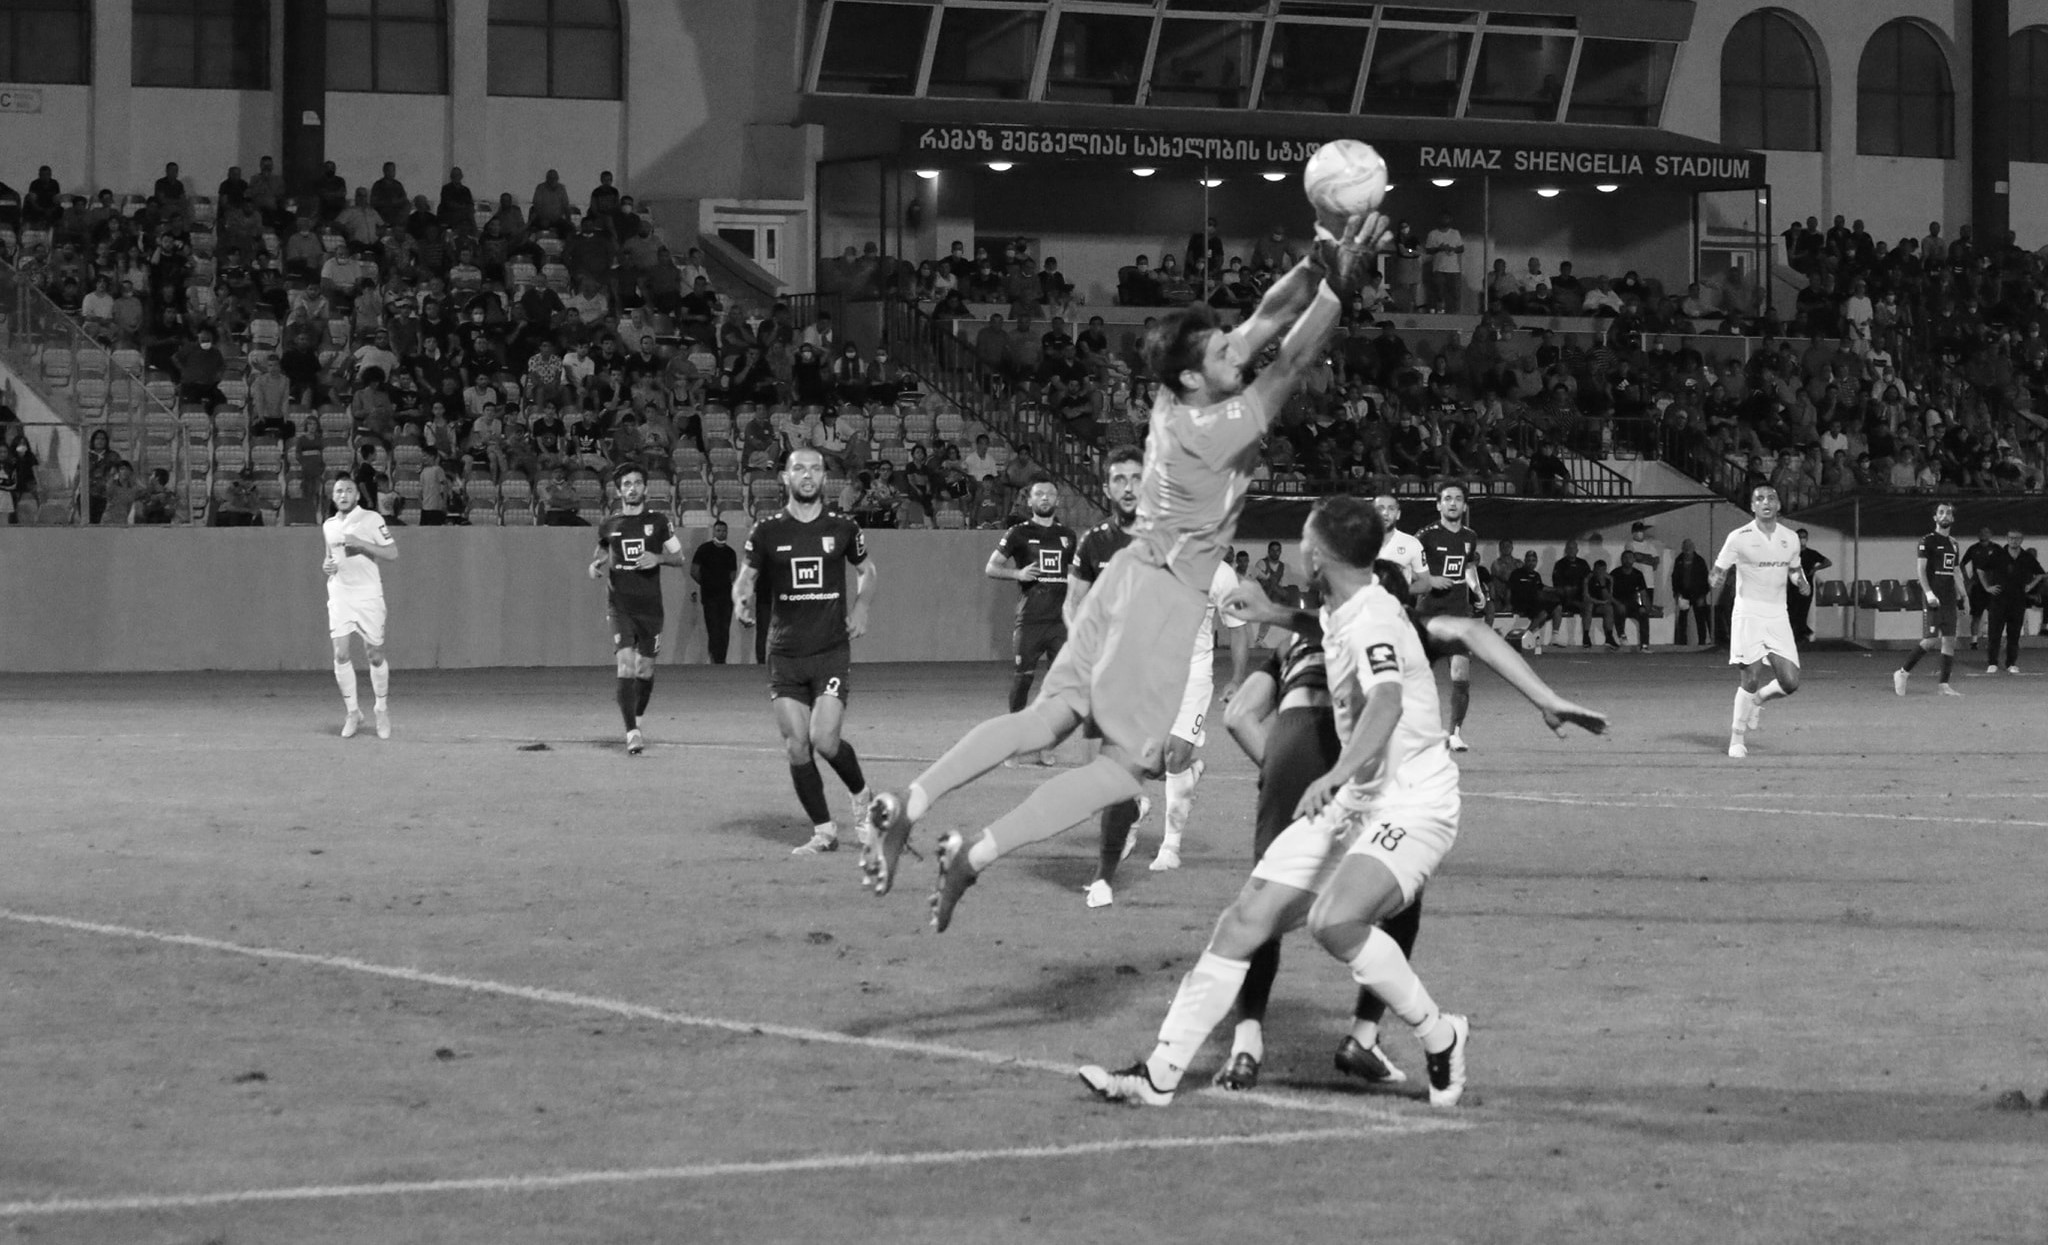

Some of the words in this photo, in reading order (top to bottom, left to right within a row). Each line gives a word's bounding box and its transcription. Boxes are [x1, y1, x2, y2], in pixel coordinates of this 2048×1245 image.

[920, 128, 993, 150] რამაზ
[1001, 131, 1126, 155] შენგელიას
[1134, 135, 1260, 160] სახელობის
[1267, 140, 1321, 161] სტად
[1420, 147, 1502, 170] RAMAZ
[1514, 150, 1643, 175] SHENGELIA
[1655, 156, 1750, 179] STADIUM
[1192, 714, 1204, 735] 9
[1371, 822, 1406, 851] 18
